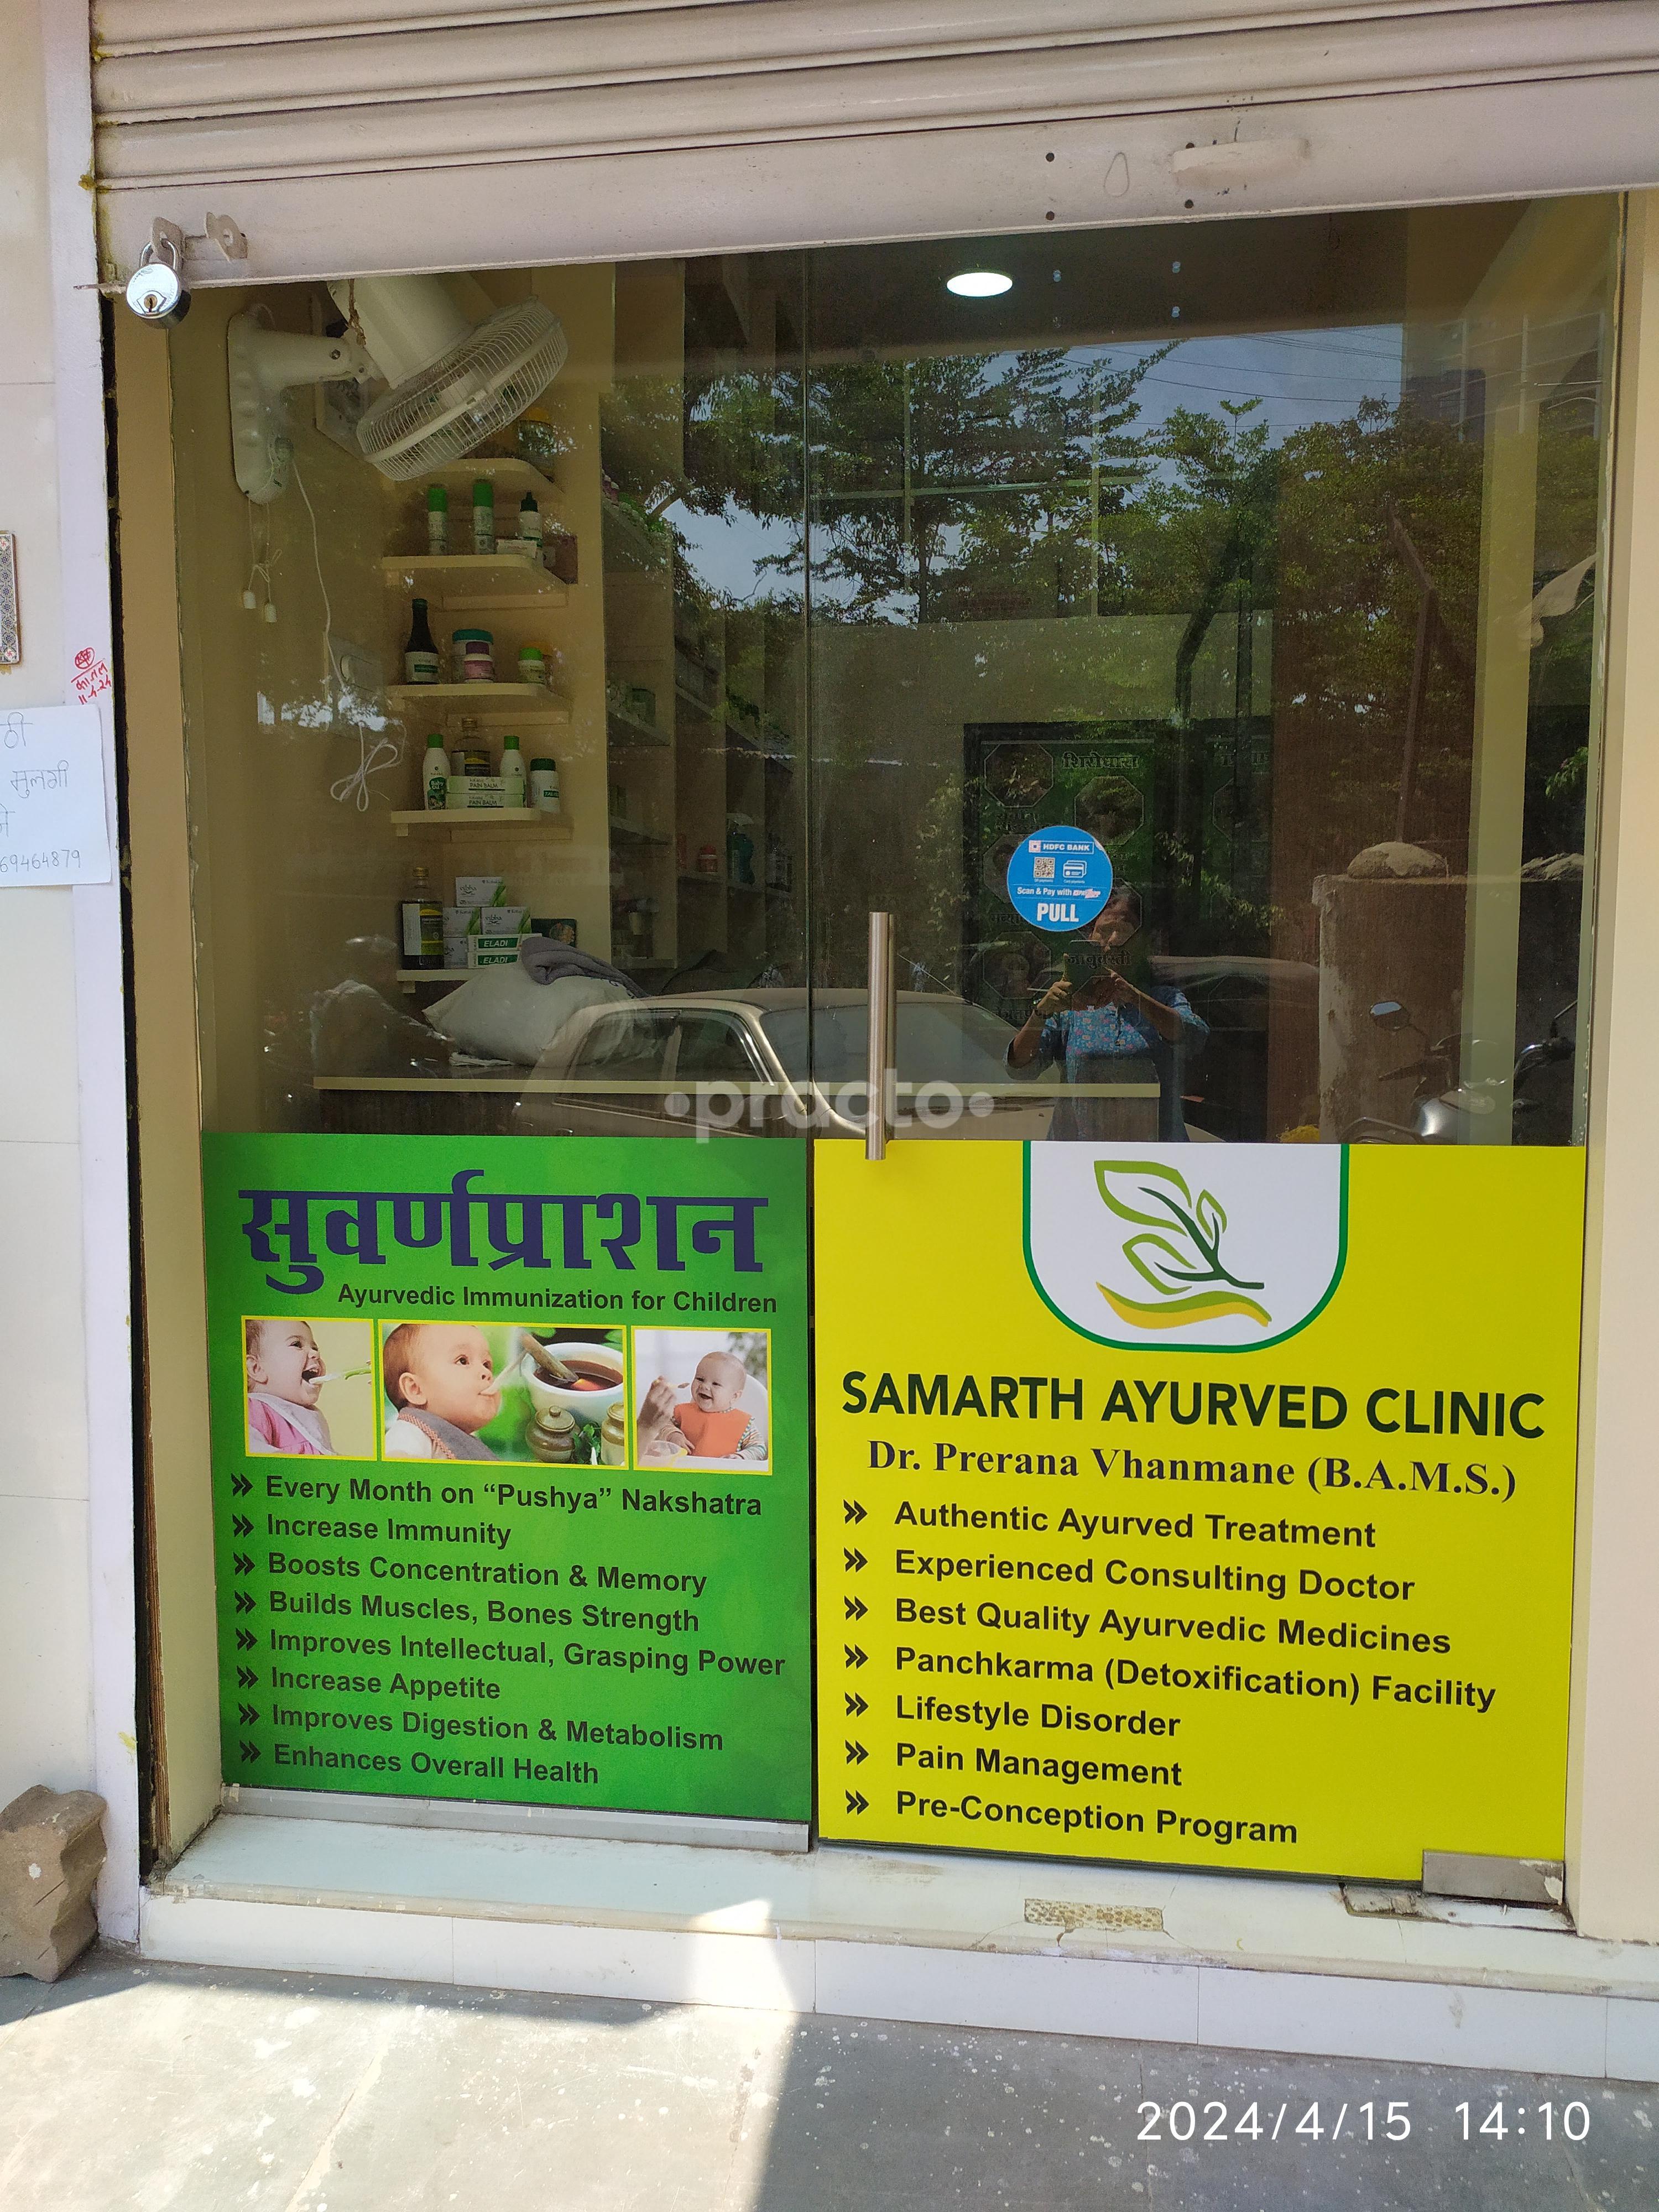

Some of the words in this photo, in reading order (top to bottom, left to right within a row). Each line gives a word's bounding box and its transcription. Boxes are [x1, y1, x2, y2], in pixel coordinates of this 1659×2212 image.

[11, 760, 69, 798] मुलगी
[1036, 902, 1079, 922] PULL
[1043, 888, 1055, 896] Pay
[238, 1169, 769, 1295] सुवर्णप्राशन
[338, 1283, 455, 1308] Ayurvedic
[463, 1286, 623, 1310] Immunization
[631, 1290, 666, 1311] for
[674, 1291, 776, 1313] Children
[842, 1371, 1083, 1420] SAMARTH
[1100, 1380, 1348, 1430] AYURVED
[1366, 1388, 1545, 1439] CLINIC
[868, 1441, 920, 1470] Dr.
[933, 1443, 1079, 1477] Prerana
[1091, 1448, 1295, 1485] Vhanmane
[1308, 1457, 1516, 1503] (B.A.M.S.)
[266, 1475, 341, 1505] Every
[349, 1478, 431, 1503] Month
[441, 1487, 473, 1504] on
[622, 1488, 761, 1516] Nakshatra
[268, 1513, 378, 1539] Increase
[388, 1518, 512, 1550] Immunity
[894, 1501, 1048, 1531] Authentic
[1057, 1508, 1193, 1540] Ayurved
[1204, 1514, 1376, 1548] Treatment
[268, 1552, 361, 1577] Boosts
[370, 1556, 559, 1585] Concentration
[568, 1564, 588, 1588] &
[598, 1566, 707, 1598] Memory
[896, 1549, 1093, 1583] Experienced
[1105, 1559, 1286, 1600] Consulting
[1300, 1569, 1416, 1600] Doctor
[270, 1590, 352, 1615] Builds
[362, 1594, 477, 1625] Muscles,
[488, 1600, 572, 1626] Bones
[582, 1604, 698, 1636] Strength
[896, 1598, 967, 1626] Best
[977, 1602, 1091, 1639] Quality
[1099, 1609, 1266, 1642] Ayurvedic
[1279, 1619, 1451, 1654] Medicines
[270, 1628, 391, 1657] Improves
[401, 1635, 554, 1668] Intellectual,
[564, 1642, 688, 1676] Grasping
[699, 1649, 786, 1676] Power
[271, 1666, 382, 1693] Increase
[389, 1673, 500, 1702] Appetite
[896, 1646, 1093, 1682] Panchkarma
[1105, 1658, 1359, 1706] (Detoxification)
[1373, 1675, 1496, 1714] Facility
[272, 1703, 393, 1732] Improves
[403, 1711, 528, 1740] Digestion
[538, 1718, 557, 1741] &
[567, 1720, 723, 1751] Metabolism
[897, 1695, 1029, 1731] Lifestyle
[1041, 1704, 1181, 1736] Disorder
[274, 1743, 402, 1772] Enhances
[411, 1752, 504, 1778] Overall
[514, 1757, 598, 1784] Health
[897, 1742, 963, 1771] Pain
[976, 1747, 1182, 1786] Management
[897, 1790, 1144, 1833] Pre-Conception
[1157, 1809, 1297, 1845] Program
